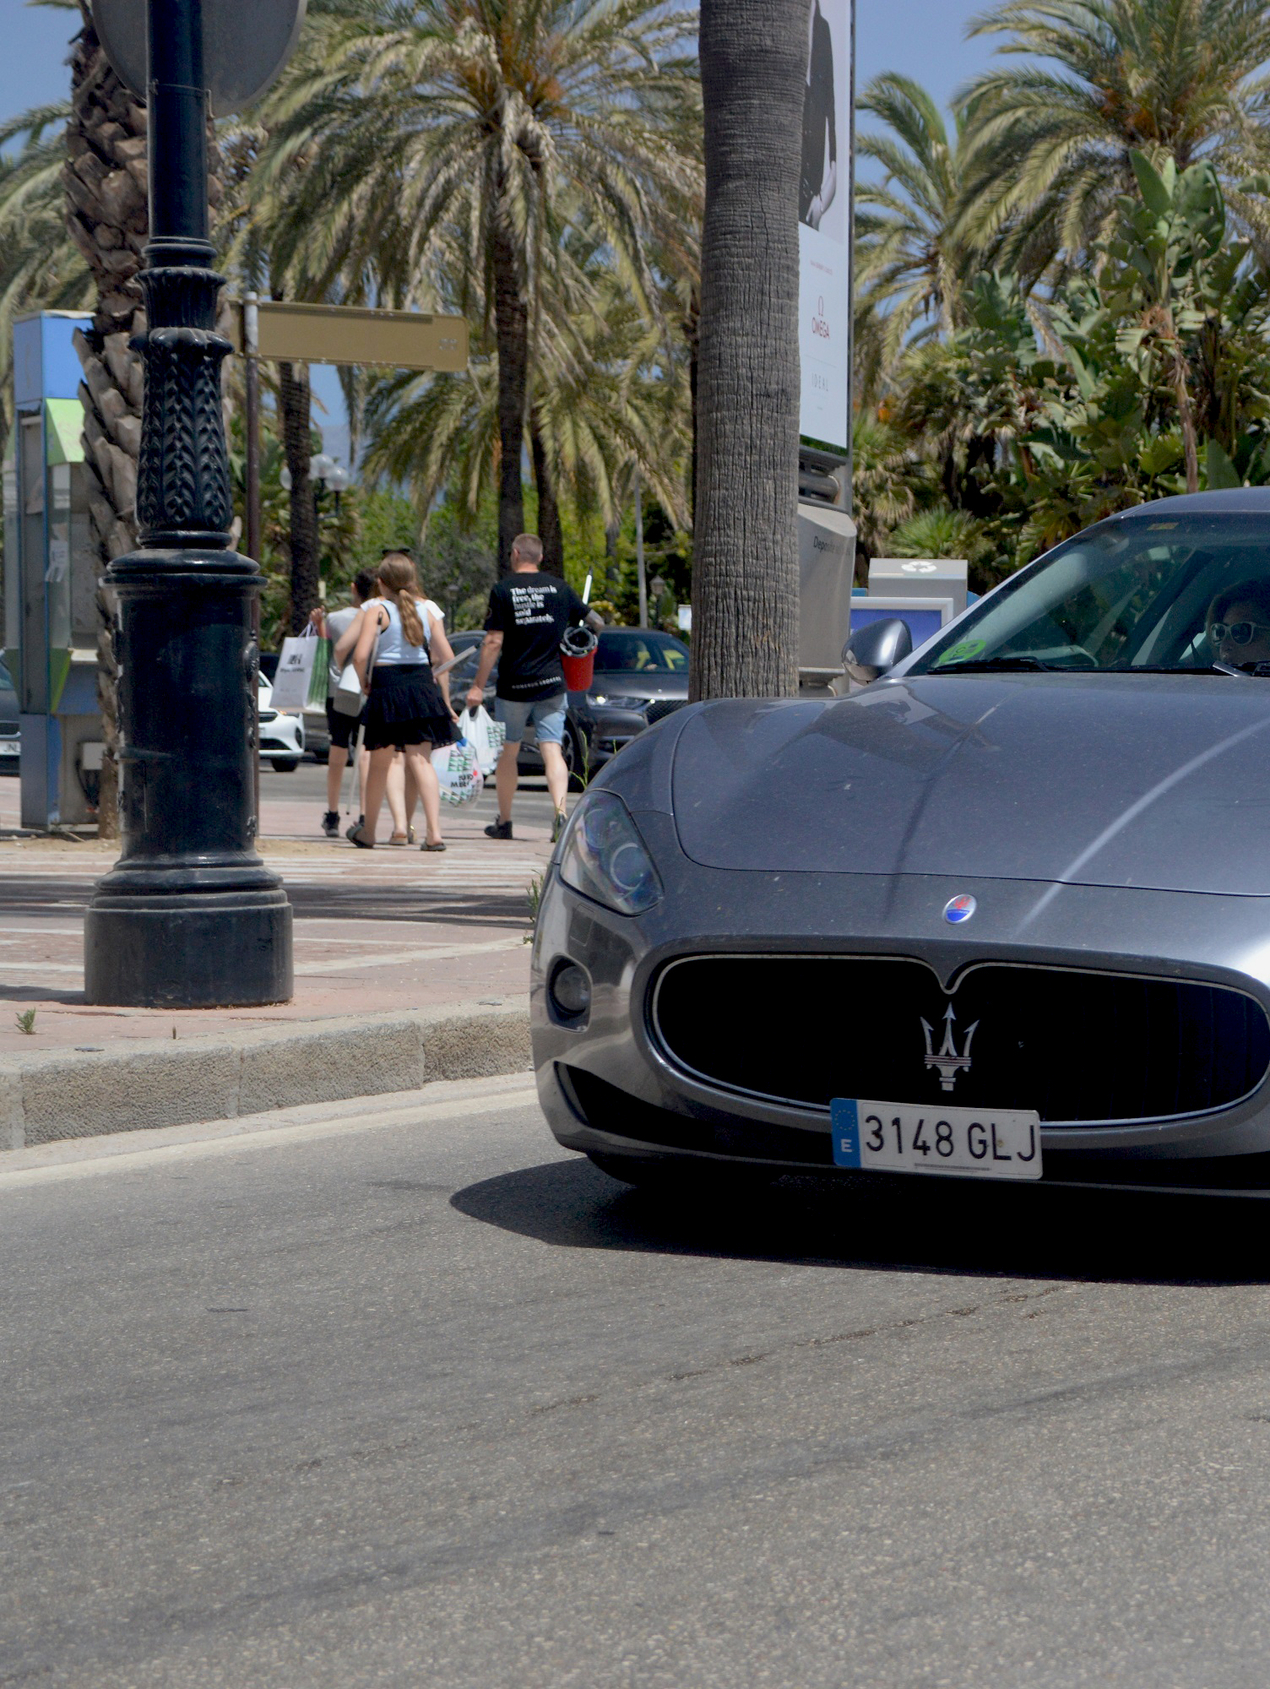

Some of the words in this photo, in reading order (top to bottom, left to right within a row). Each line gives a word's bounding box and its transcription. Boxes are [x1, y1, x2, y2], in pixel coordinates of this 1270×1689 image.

[812, 317, 830, 339] OMEGA
[812, 373, 828, 392] IDEAL
[510, 587, 526, 596] The
[527, 586, 550, 594] dream
[550, 584, 558, 594] is
[512, 594, 532, 603] free,
[531, 593, 544, 601] the
[514, 608, 531, 617] sold
[841, 1138, 852, 1153] E
[865, 1115, 954, 1158] 3148
[968, 1122, 1036, 1162] GLJ
